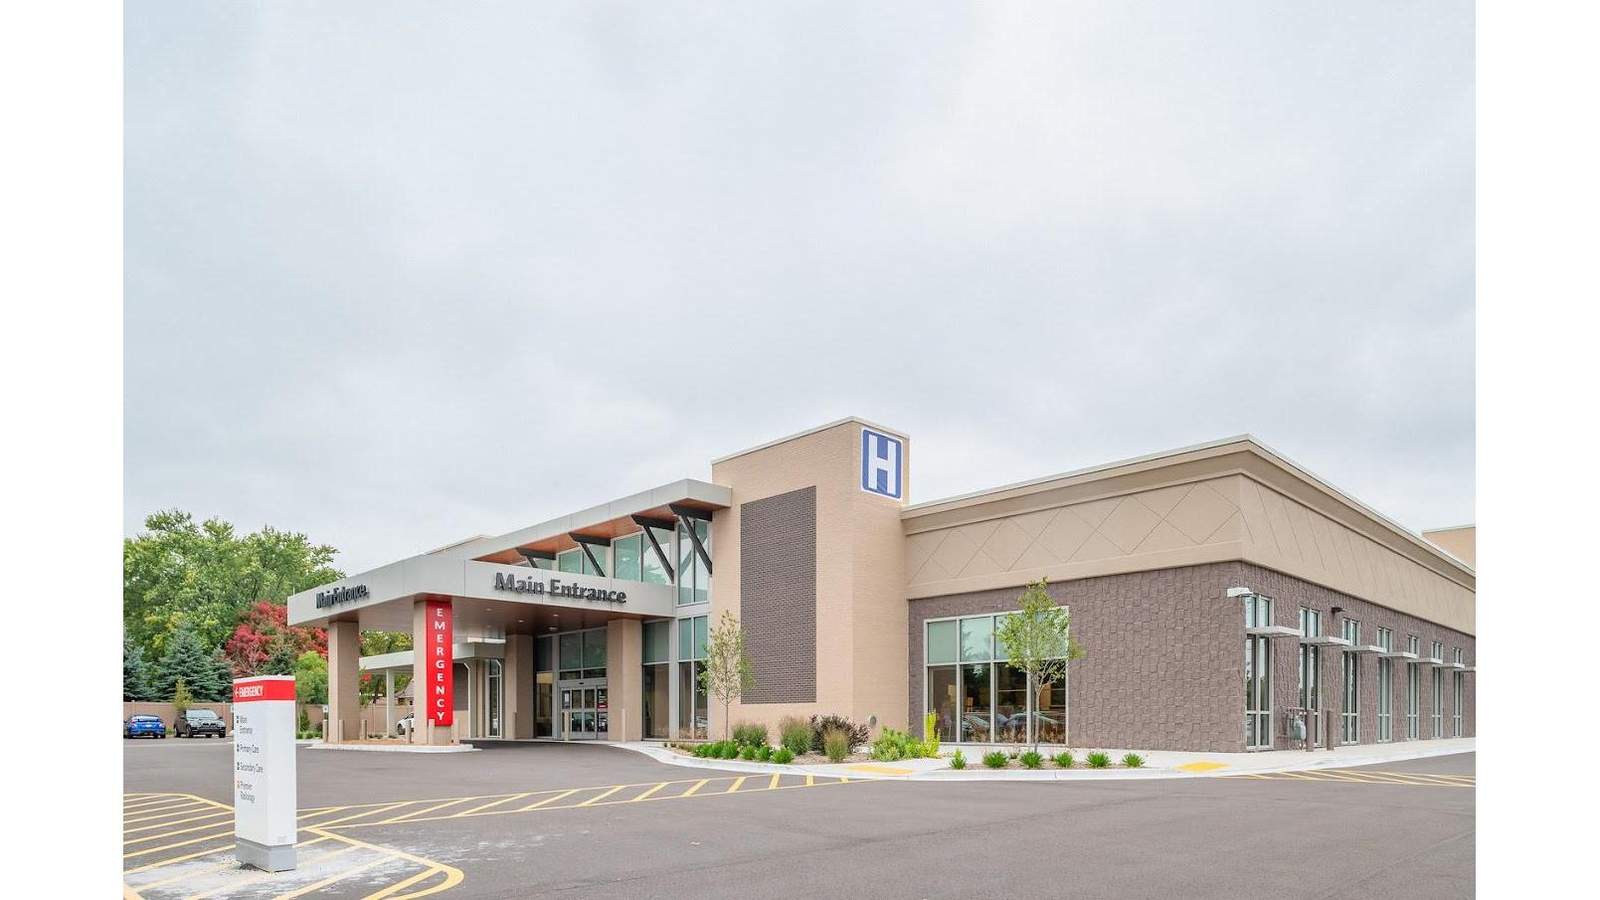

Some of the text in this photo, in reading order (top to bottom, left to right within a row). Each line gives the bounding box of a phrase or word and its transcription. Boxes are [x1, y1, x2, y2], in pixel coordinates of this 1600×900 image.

[868, 433, 897, 496] H
[332, 583, 370, 605] Entrance
[495, 571, 627, 604] Main Entrance
[434, 607, 446, 721] EMERGENCY
[239, 685, 264, 698] EMERGENCY
